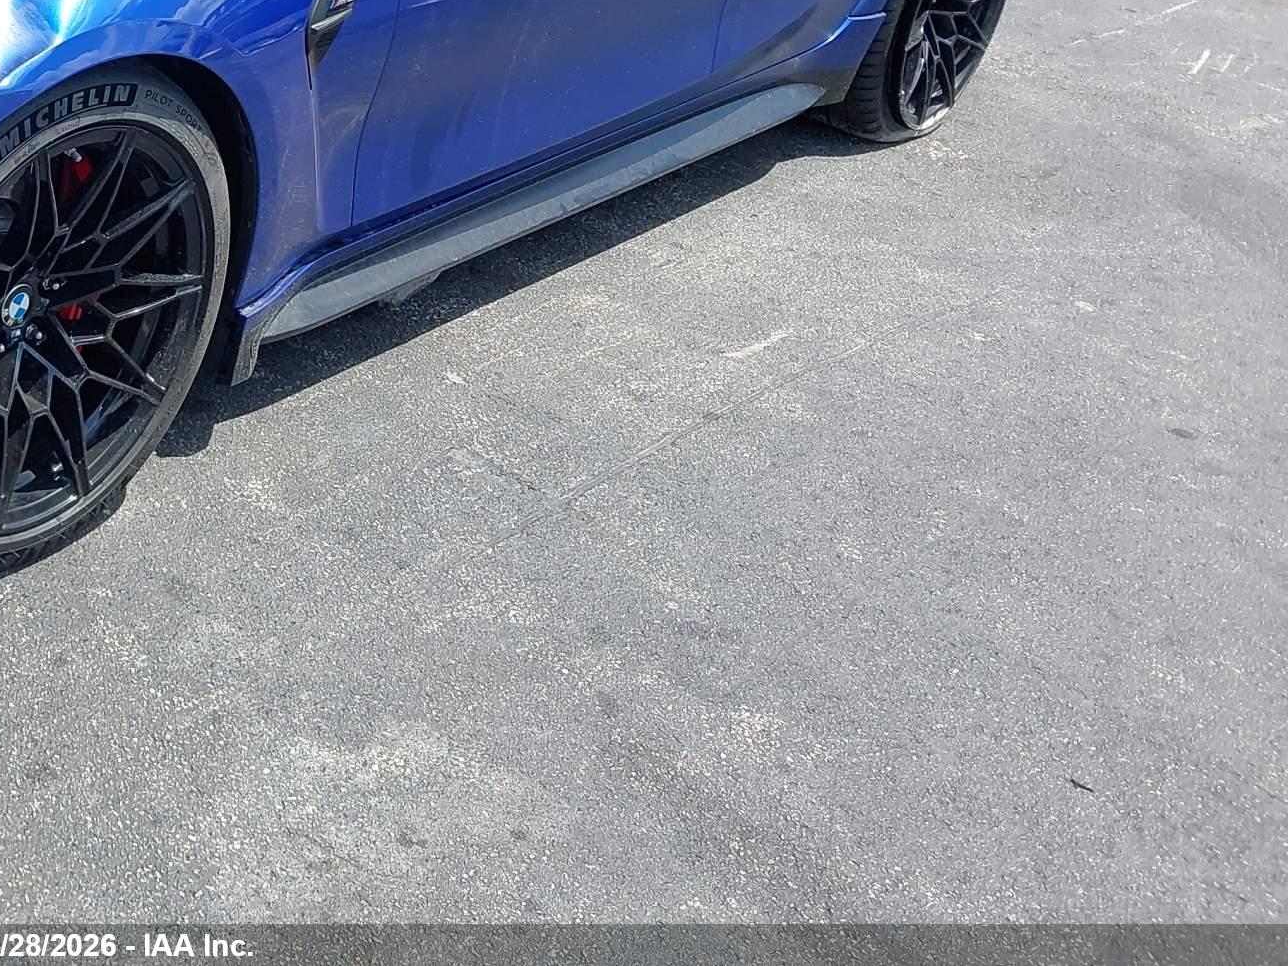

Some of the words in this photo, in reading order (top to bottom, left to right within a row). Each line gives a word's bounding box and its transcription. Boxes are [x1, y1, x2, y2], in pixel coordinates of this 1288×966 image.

[0, 84, 131, 158] MICHELIN
[144, 89, 174, 108] PILOT
[175, 105, 203, 132] SPORT
